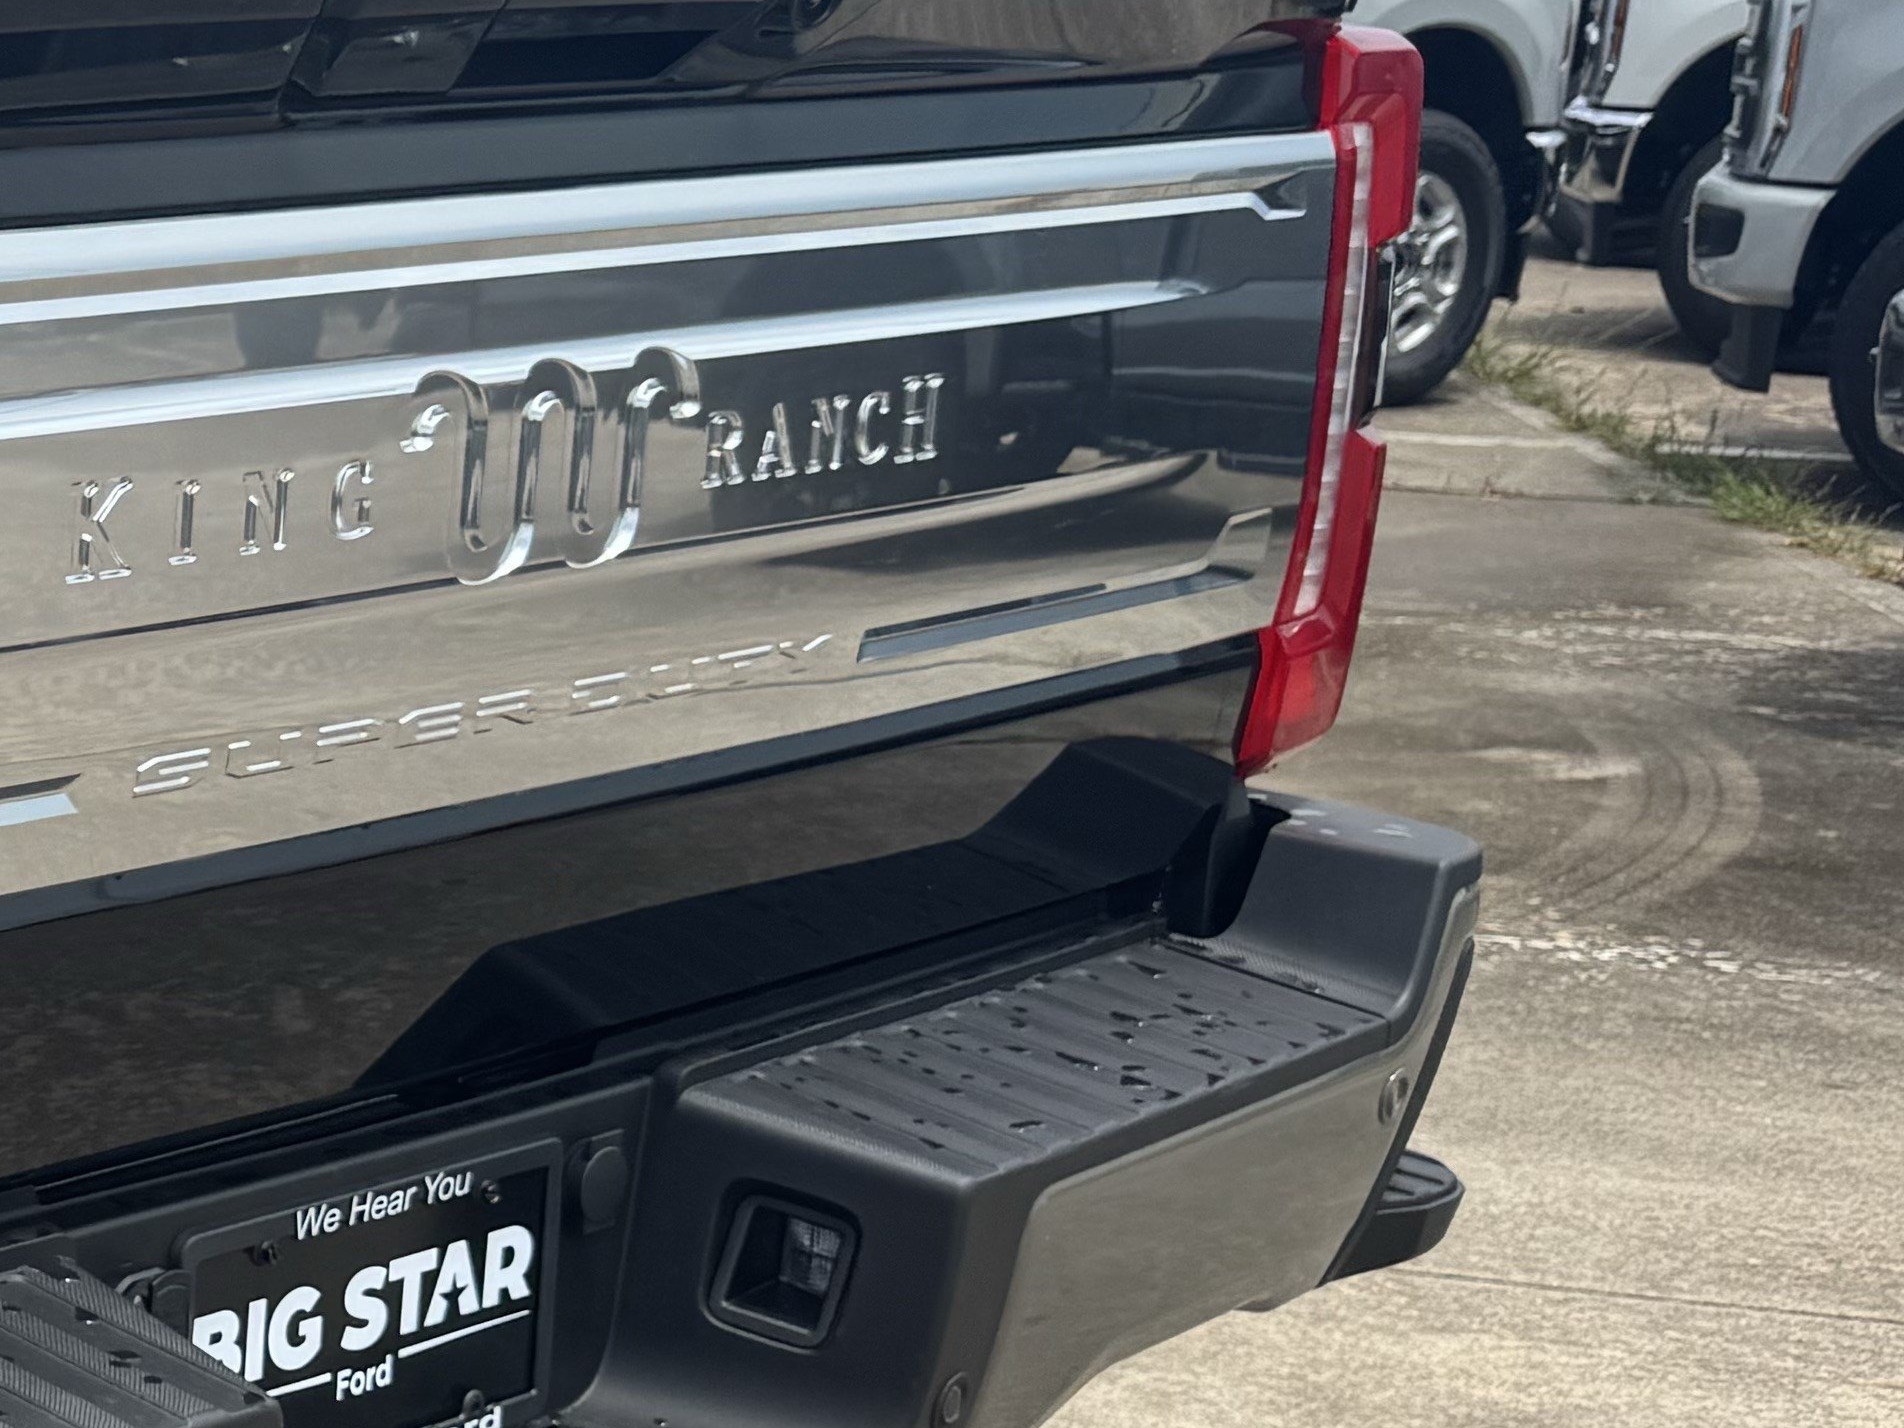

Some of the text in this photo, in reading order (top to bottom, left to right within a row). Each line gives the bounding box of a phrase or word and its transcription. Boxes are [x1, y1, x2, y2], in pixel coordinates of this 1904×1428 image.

[65, 373, 945, 584] KING RANCH
[132, 634, 834, 798] SUPER DUTY
[295, 1171, 473, 1241] We Hear You
[192, 1225, 535, 1382] BIG STAR
[336, 1353, 394, 1401] Ford
